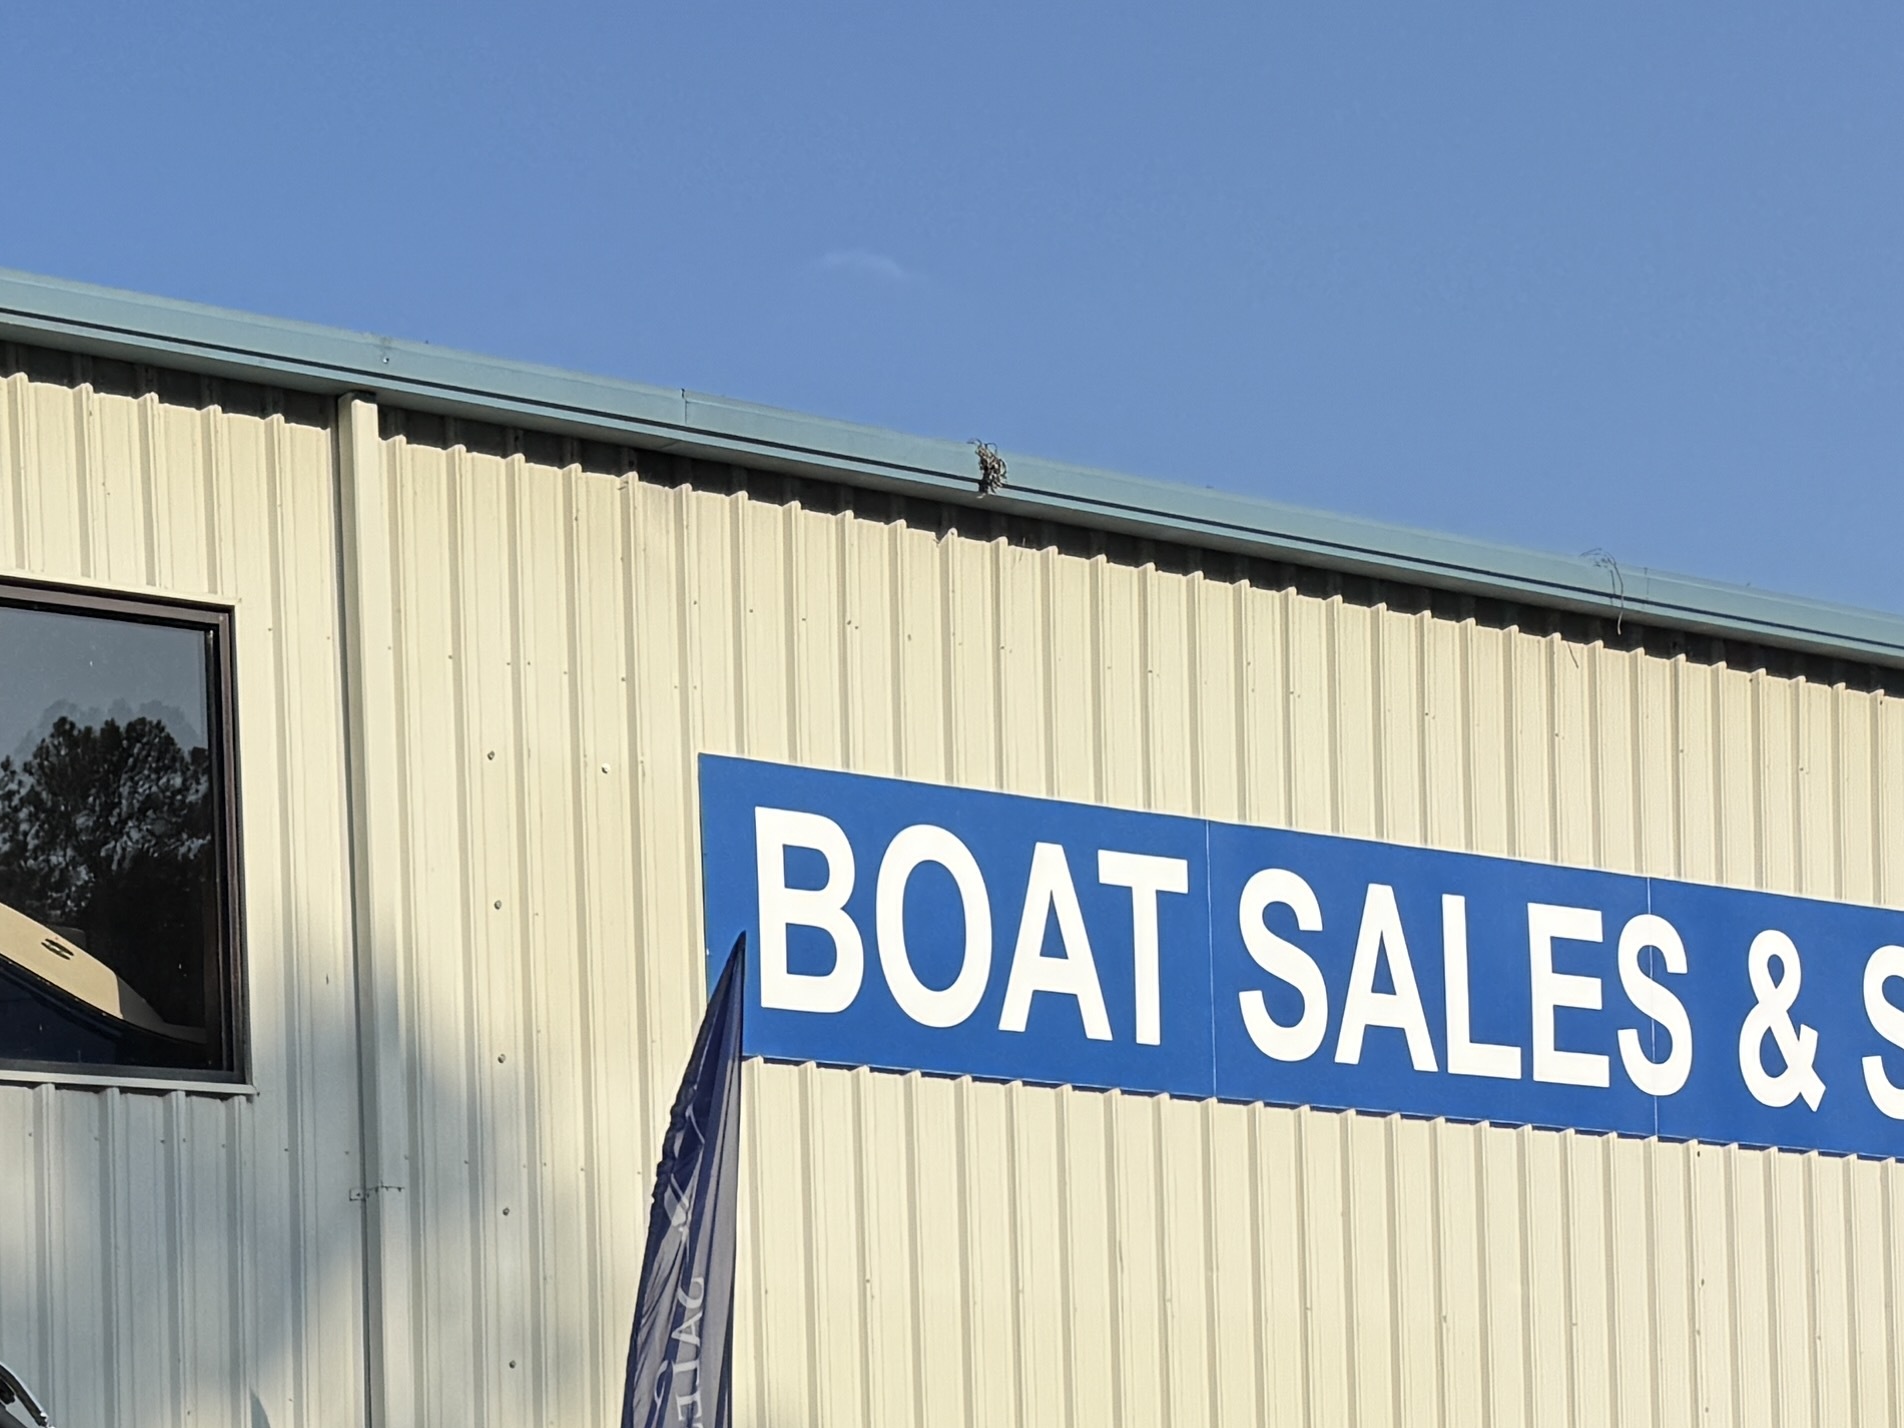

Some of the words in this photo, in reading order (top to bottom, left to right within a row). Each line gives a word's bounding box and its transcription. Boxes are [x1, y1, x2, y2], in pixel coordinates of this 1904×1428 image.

[754, 806, 1189, 1046] BOAT
[1238, 868, 1693, 1097] SALES
[1738, 929, 1826, 1113] &
